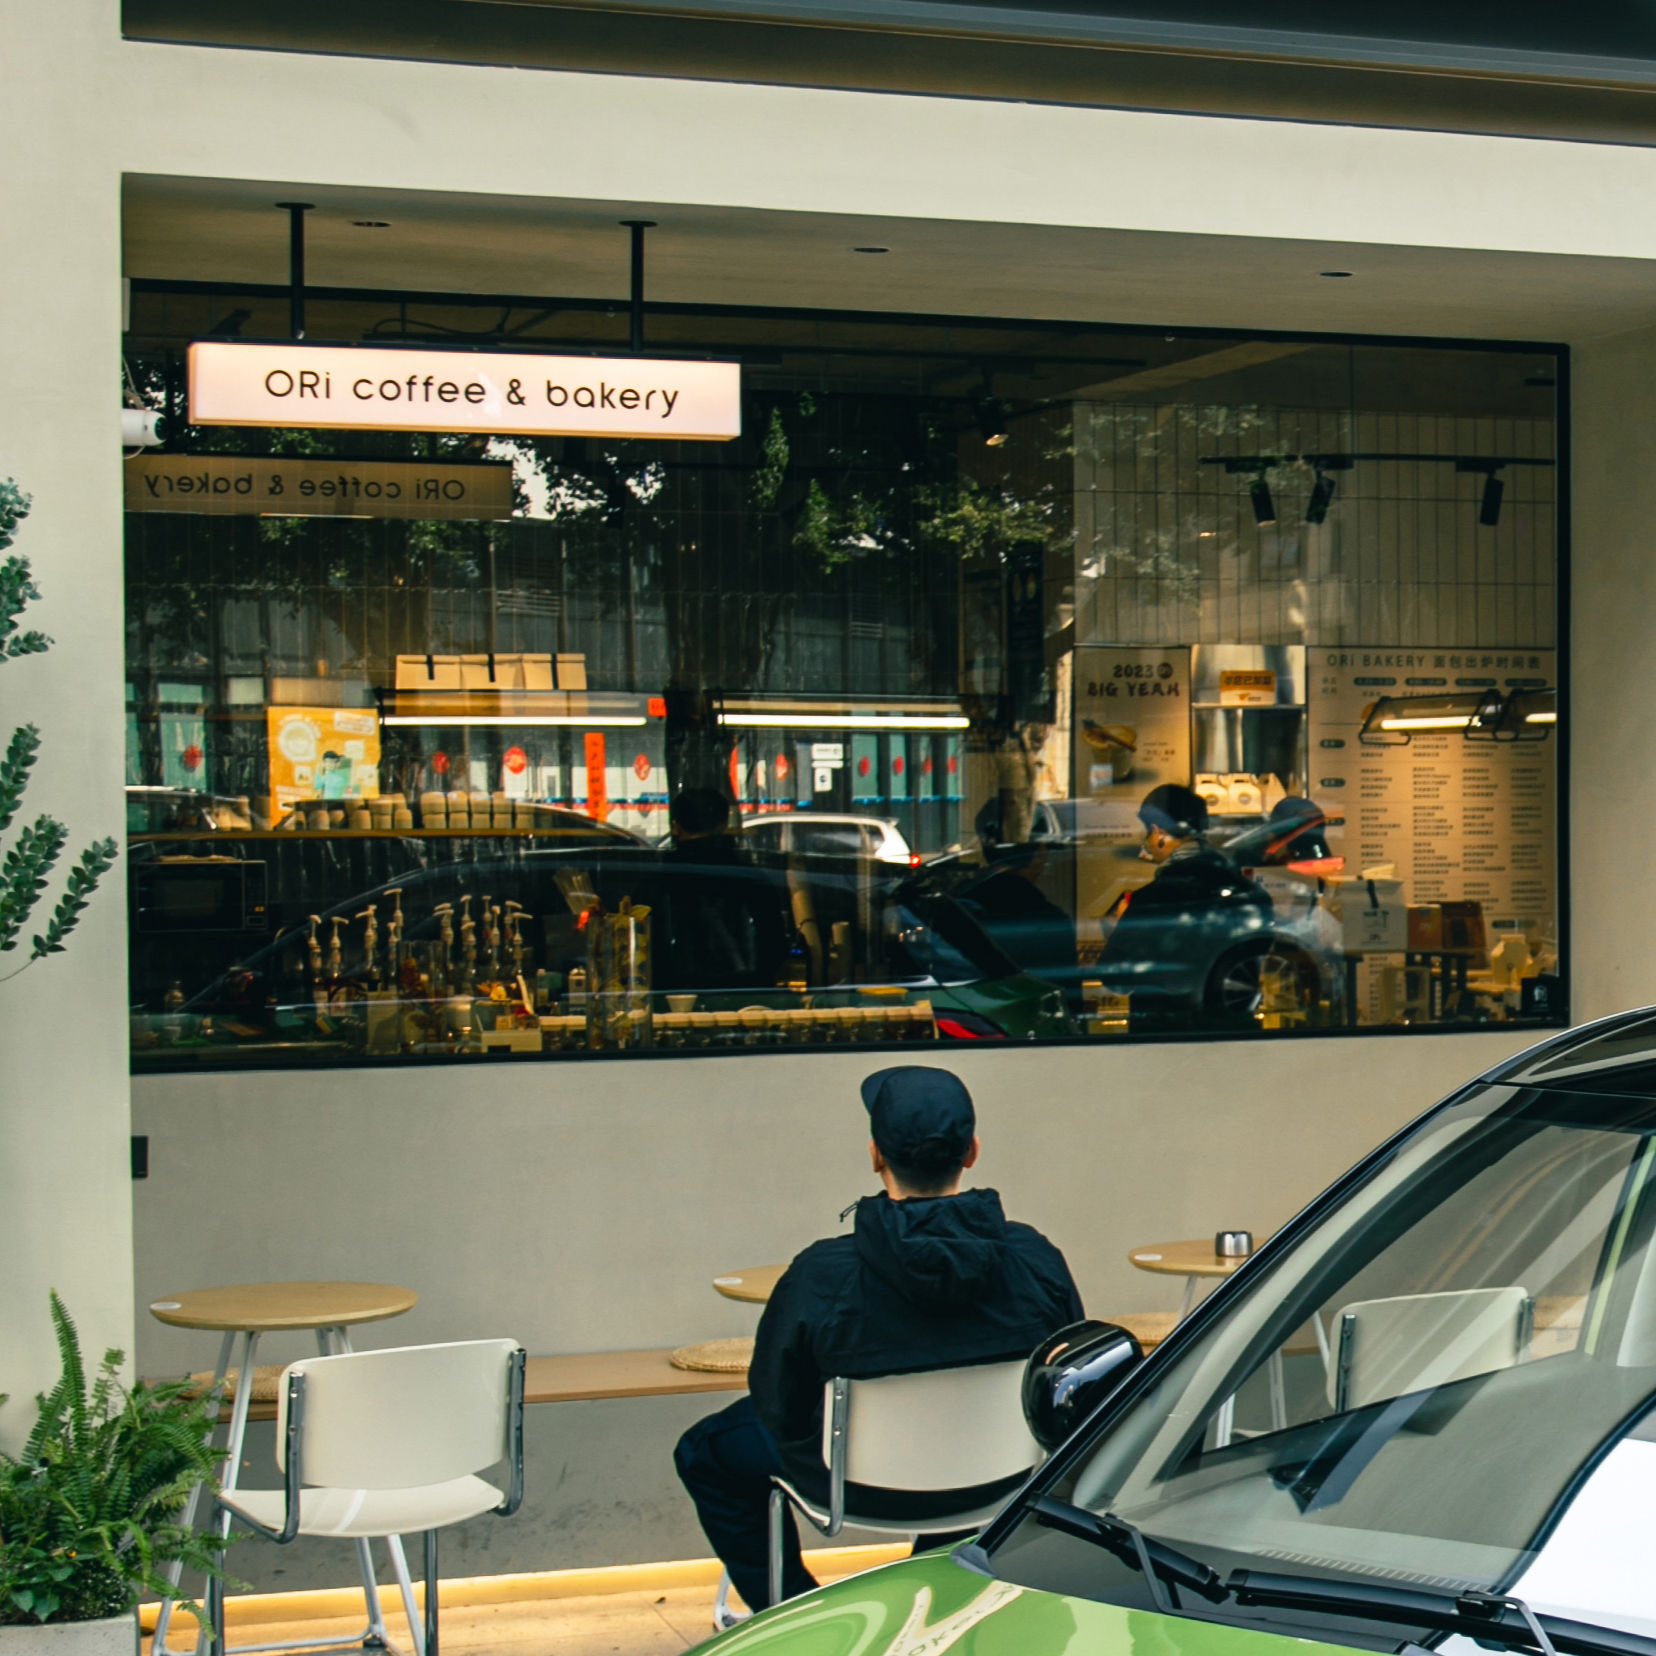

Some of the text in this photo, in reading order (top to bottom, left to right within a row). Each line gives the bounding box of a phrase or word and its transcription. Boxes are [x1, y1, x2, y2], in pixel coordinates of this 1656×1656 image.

[265, 369, 679, 419] ORi coffee & bakery
[1362, 655, 1425, 668] BAKERY
[1113, 664, 1154, 679] 2023
[1087, 682, 1180, 697] BIG YEAH
